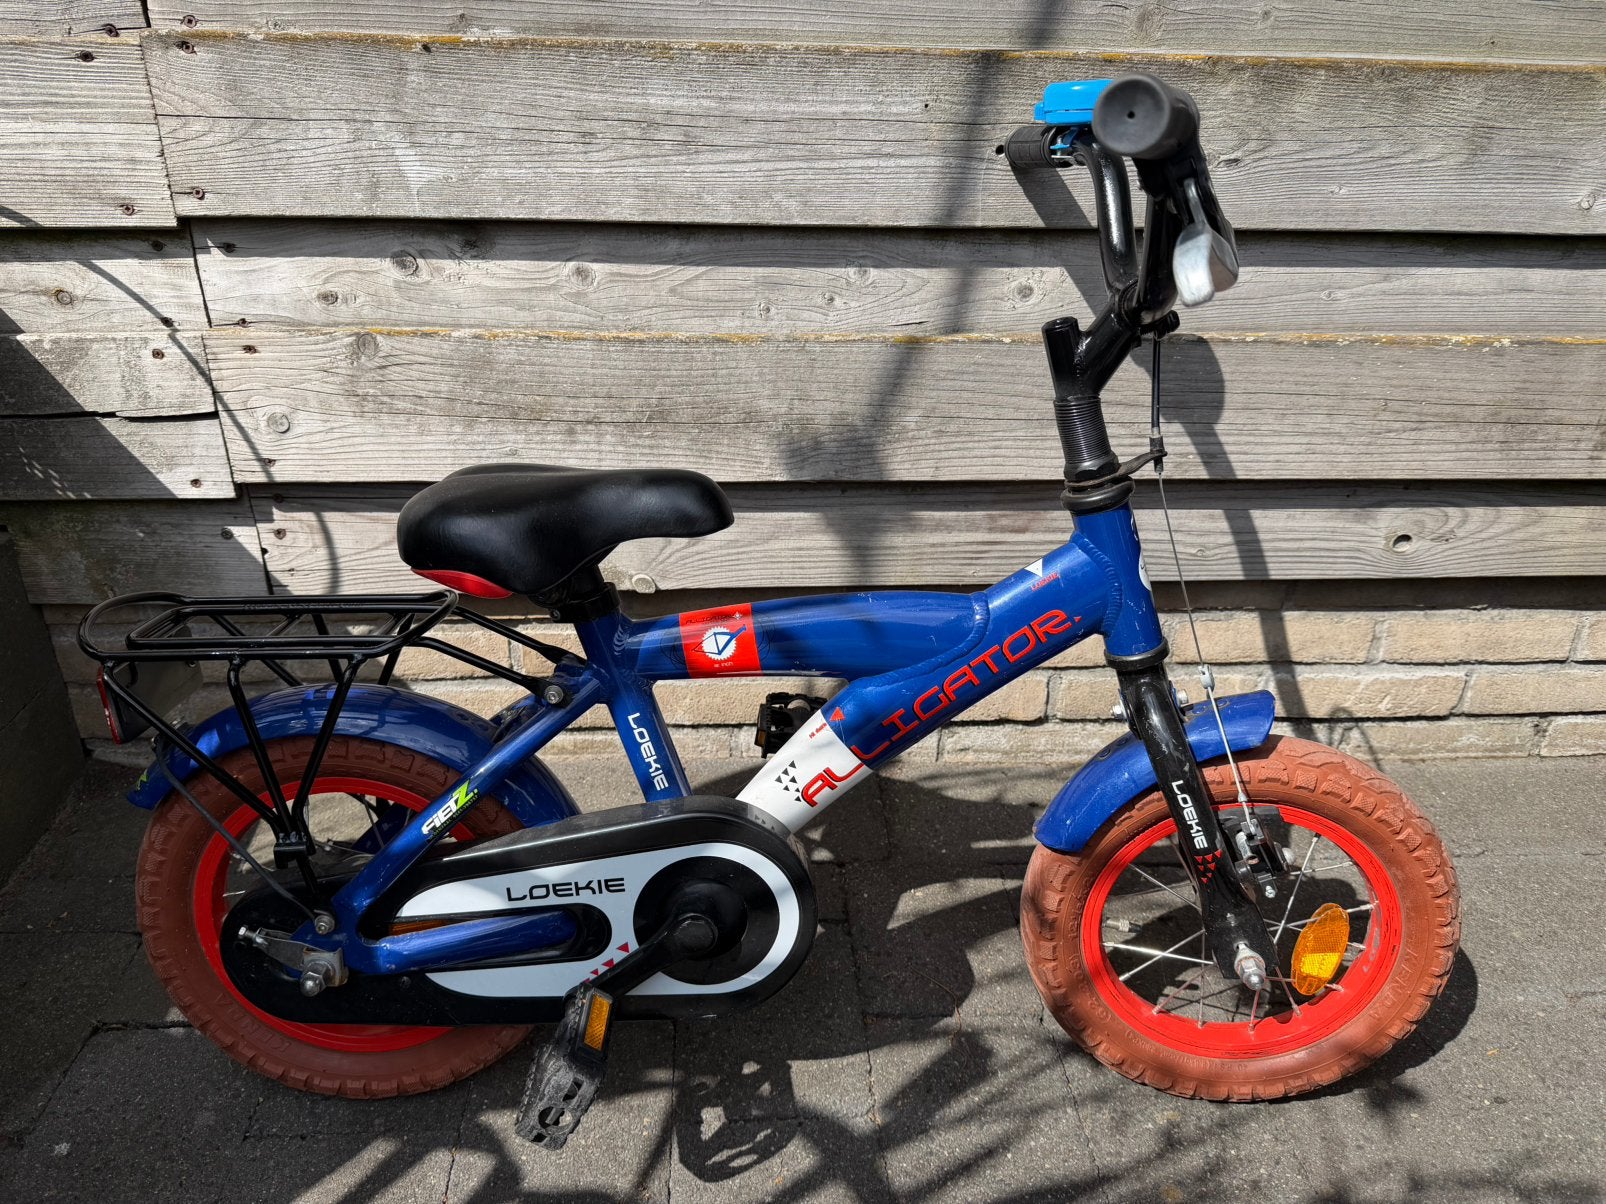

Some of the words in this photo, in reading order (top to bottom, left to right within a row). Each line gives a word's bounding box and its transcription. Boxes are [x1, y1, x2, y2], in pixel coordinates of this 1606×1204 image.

[801, 609, 1072, 808] ALLIGATOR
[627, 712, 669, 791] LOEKIE
[1171, 780, 1208, 849] LOEKIE
[506, 878, 626, 901] LOEKIE
